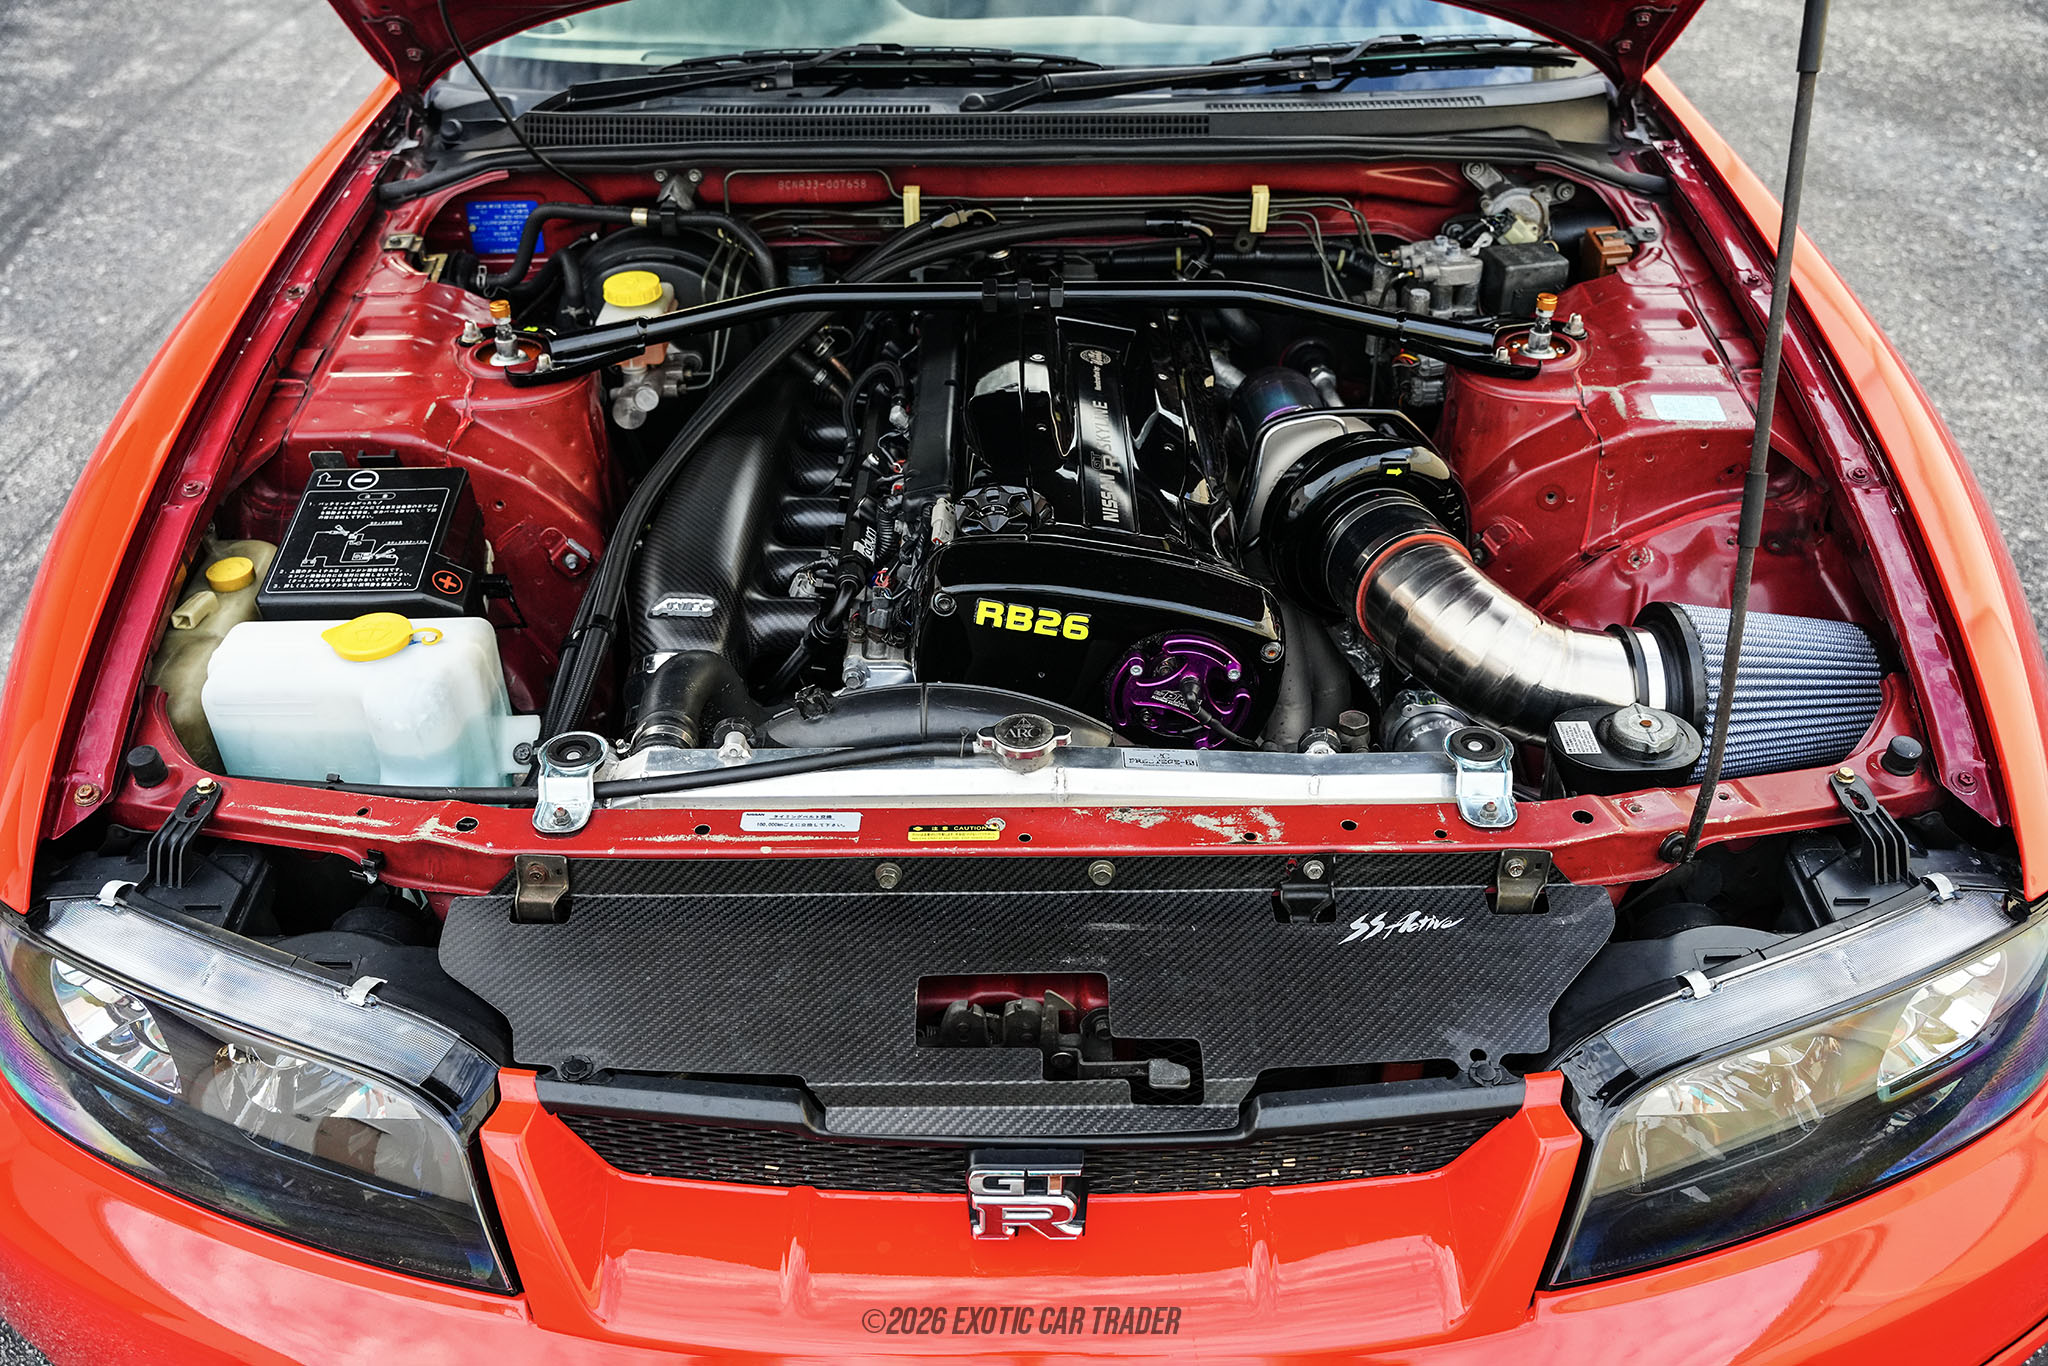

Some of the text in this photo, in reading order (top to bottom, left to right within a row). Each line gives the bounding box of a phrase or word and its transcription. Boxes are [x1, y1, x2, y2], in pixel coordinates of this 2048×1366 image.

[1093, 400, 1113, 451] SKYLINE
[1101, 474, 1120, 523] NISSAN
[975, 598, 1090, 641] RB26
[968, 1168, 1082, 1196] GT
